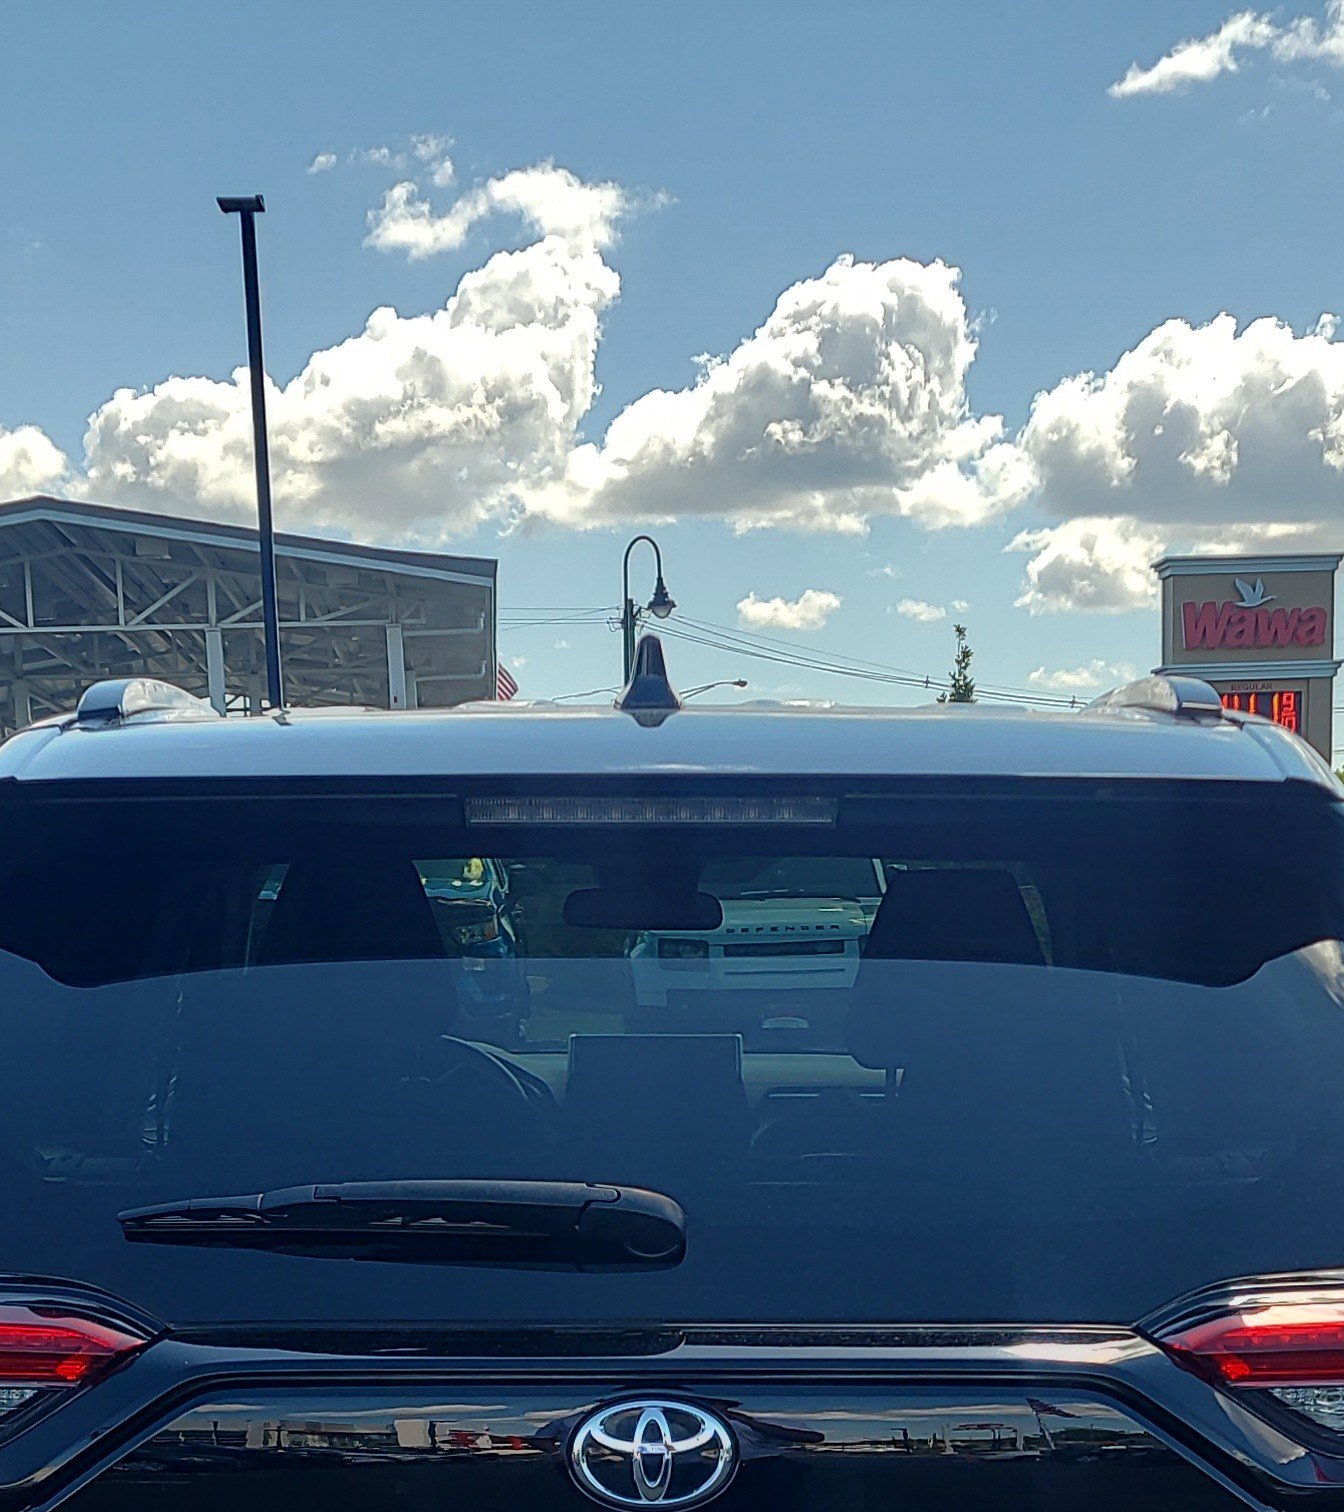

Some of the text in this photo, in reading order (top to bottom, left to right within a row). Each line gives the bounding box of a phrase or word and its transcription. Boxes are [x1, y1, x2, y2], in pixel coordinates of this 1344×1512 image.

[1182, 601, 1328, 650] Wawa
[1230, 682, 1274, 691] REGULAR
[726, 924, 841, 934] DEFENDER
